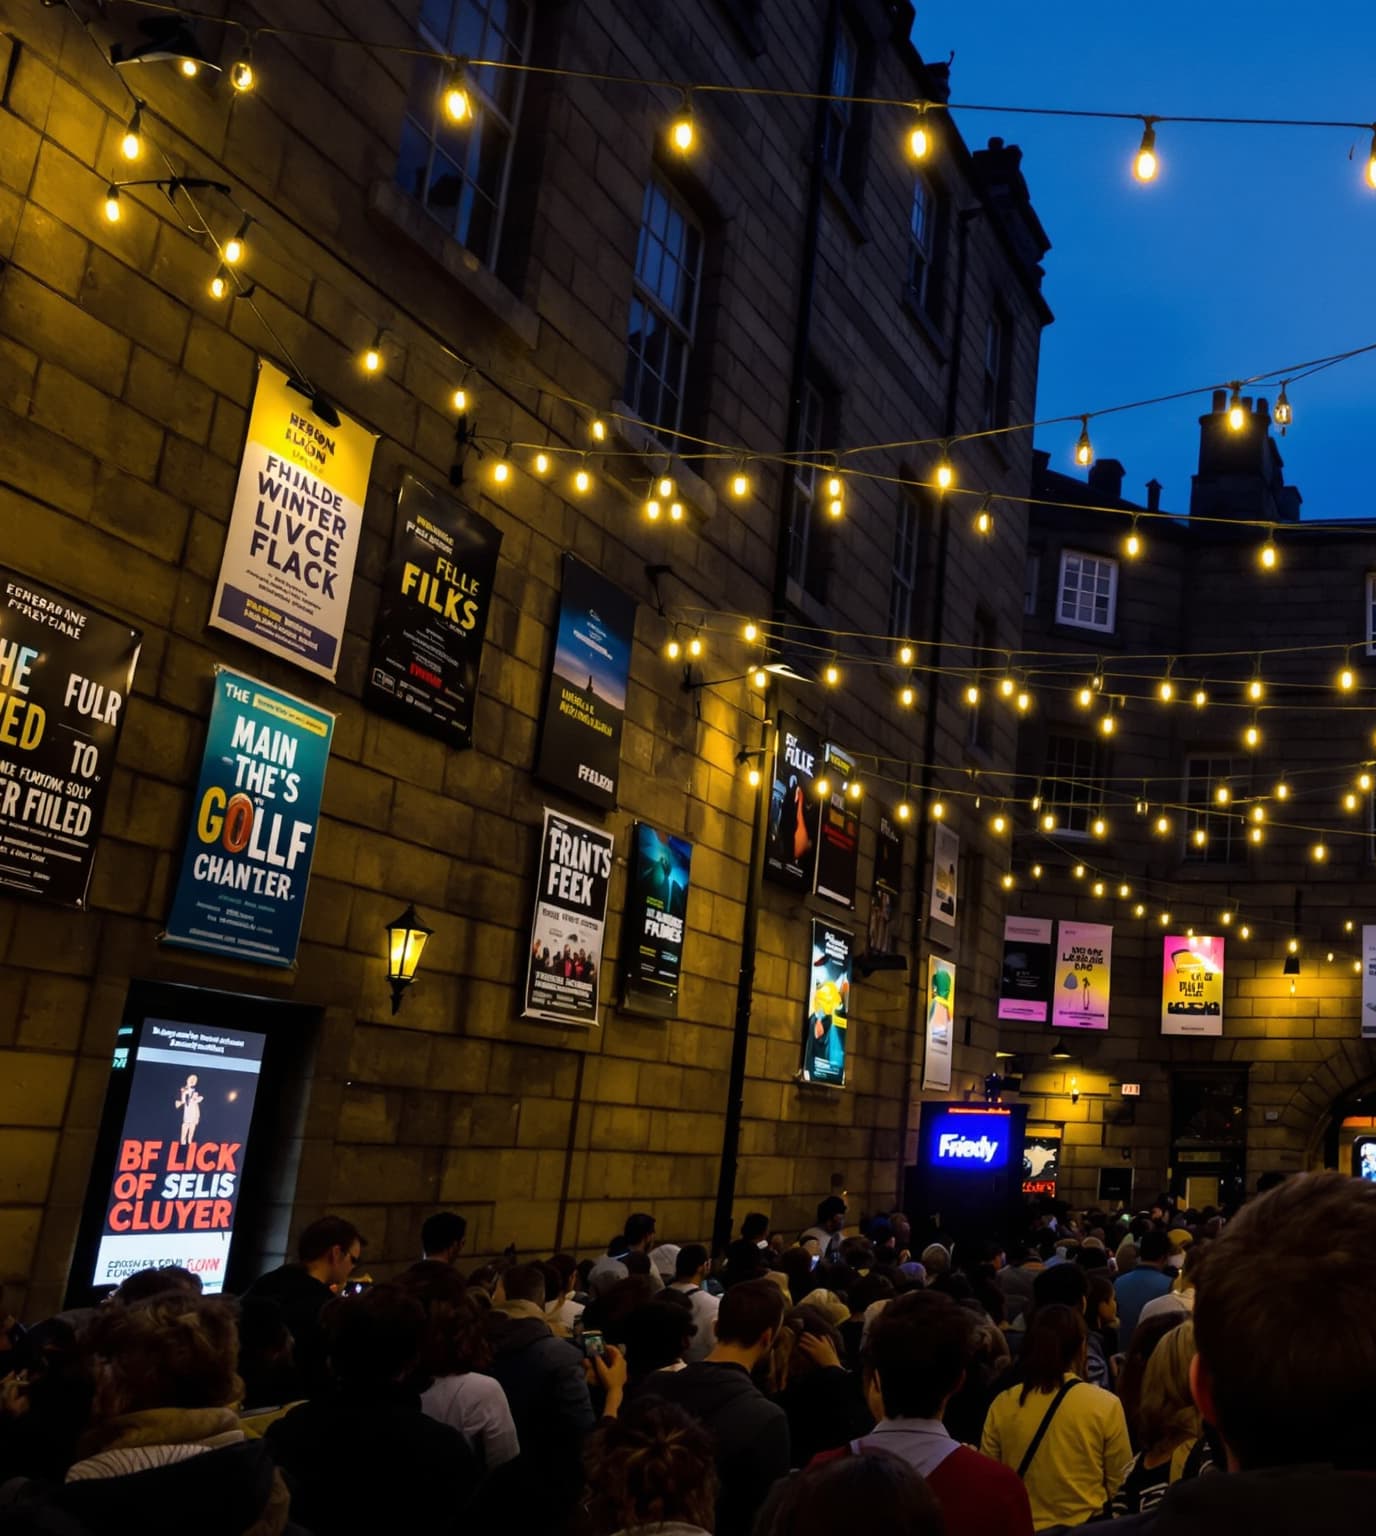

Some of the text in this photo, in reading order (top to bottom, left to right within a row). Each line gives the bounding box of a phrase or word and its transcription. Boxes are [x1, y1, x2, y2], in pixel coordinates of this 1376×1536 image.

[258, 471, 347, 540] WINTER
[255, 501, 340, 569] LIVCE
[250, 530, 338, 600] FLACK
[401, 561, 479, 630] FILKS
[0, 691, 46, 750] ED
[63, 672, 122, 727] FULR
[225, 682, 250, 704] THE
[231, 714, 298, 769] MAIN
[235, 754, 301, 803] THE'S
[197, 786, 313, 871] GOLLF
[119, 1139, 241, 1173] BF LICK
[113, 1172, 237, 1200] OF SELIS
[108, 1200, 233, 1232] CLUYER
